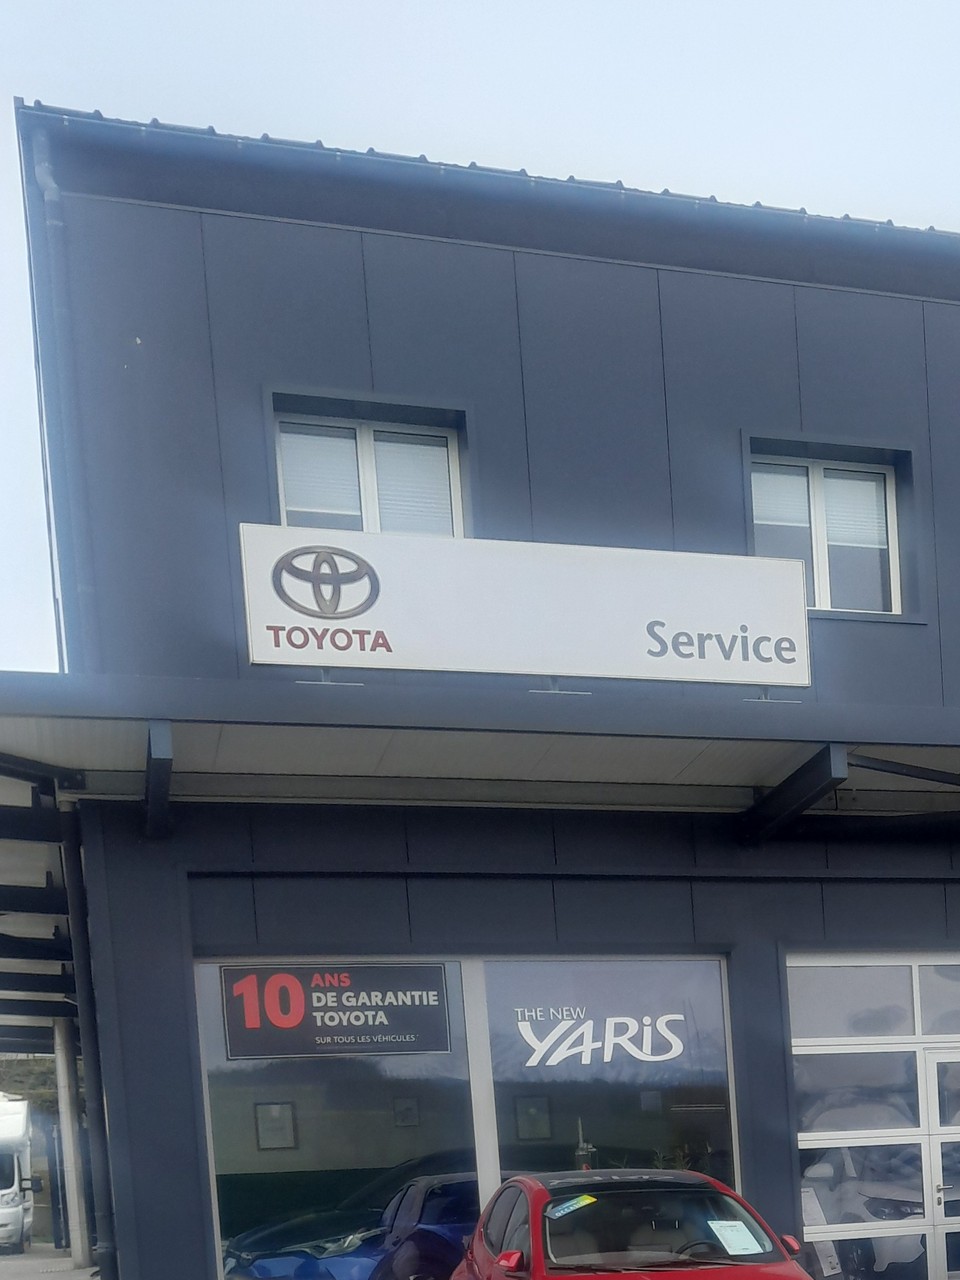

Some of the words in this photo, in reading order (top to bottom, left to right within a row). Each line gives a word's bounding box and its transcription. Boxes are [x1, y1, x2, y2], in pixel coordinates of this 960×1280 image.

[266, 625, 393, 654] TOYOTA
[645, 620, 797, 665] Service
[311, 973, 351, 988] ANS
[233, 973, 306, 1029] 10
[312, 992, 338, 1008] DE
[342, 990, 439, 1007] GARANTIE
[312, 1010, 389, 1027] TOYOTA
[514, 1007, 545, 1021] THE
[550, 1006, 587, 1020] NEW
[315, 1036, 332, 1045] SUR
[333, 1035, 356, 1044] TOUS
[357, 1035, 371, 1043] LES
